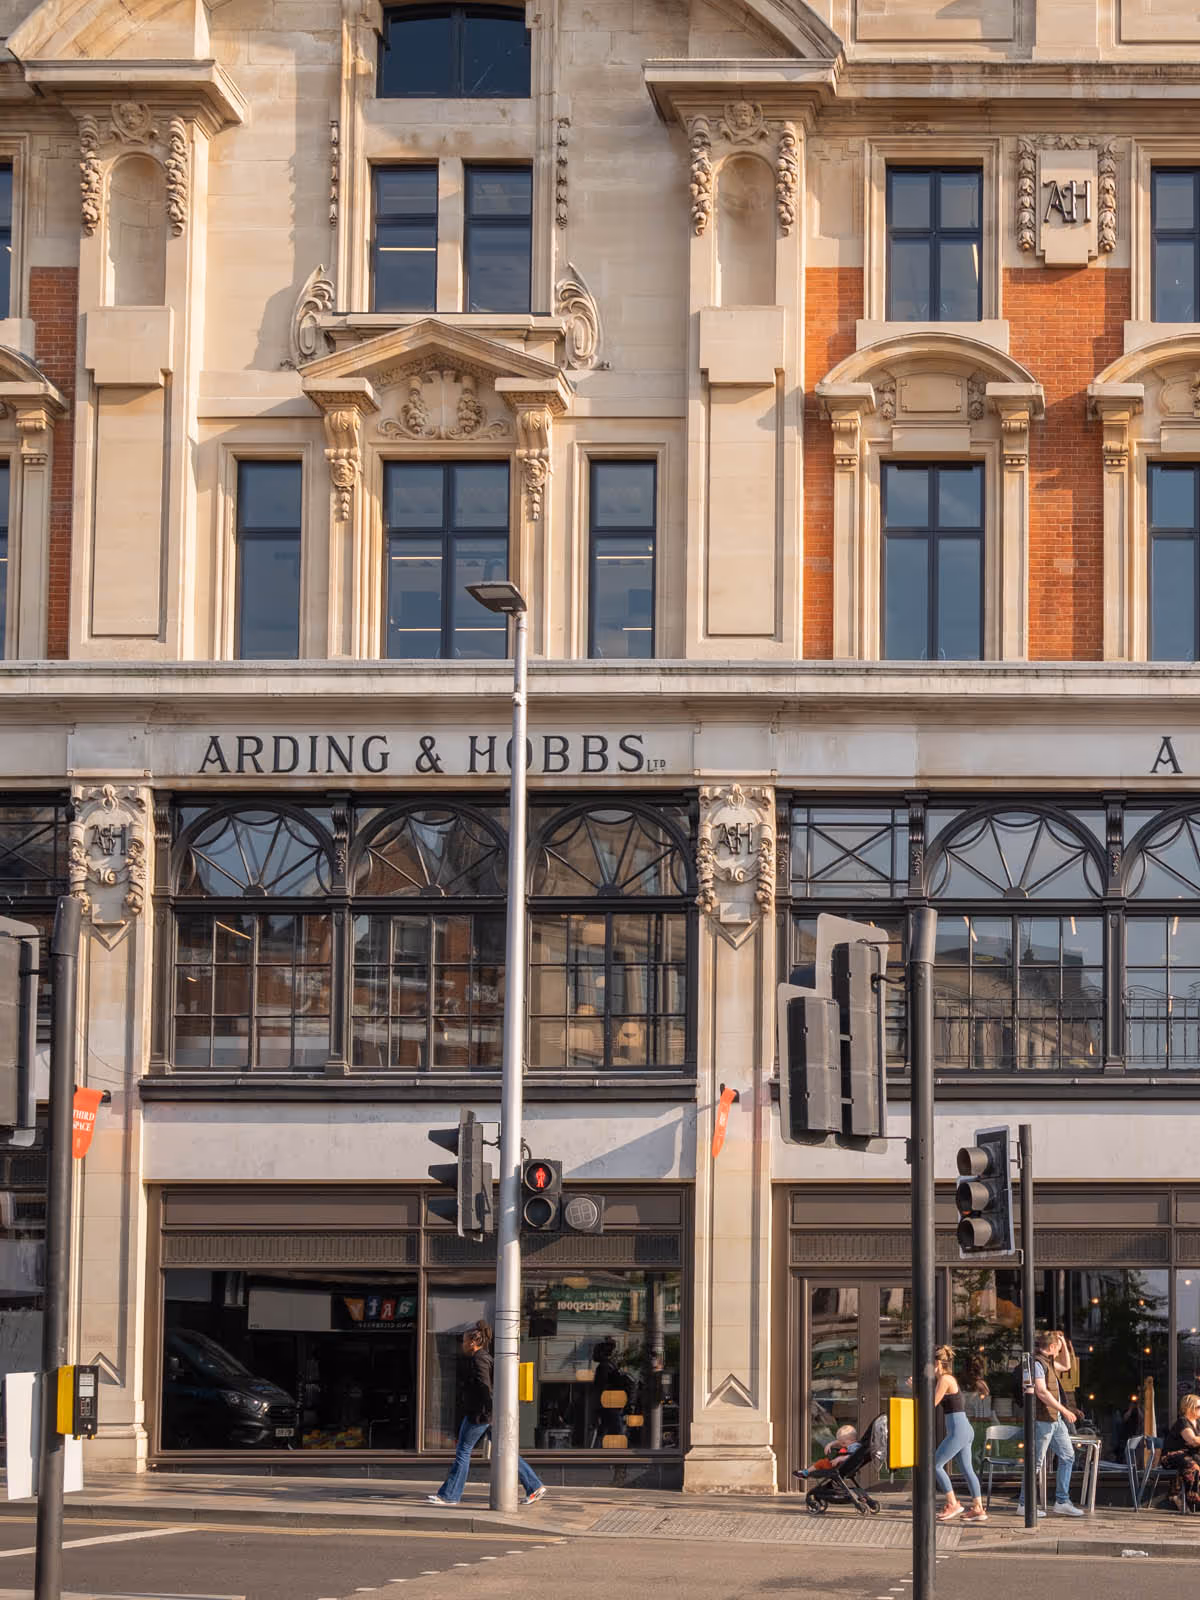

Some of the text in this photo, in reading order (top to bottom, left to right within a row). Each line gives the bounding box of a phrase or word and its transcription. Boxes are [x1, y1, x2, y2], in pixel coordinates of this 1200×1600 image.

[198, 735, 390, 773] ARDING
[415, 735, 444, 773] &
[467, 734, 644, 773] HOBBS
